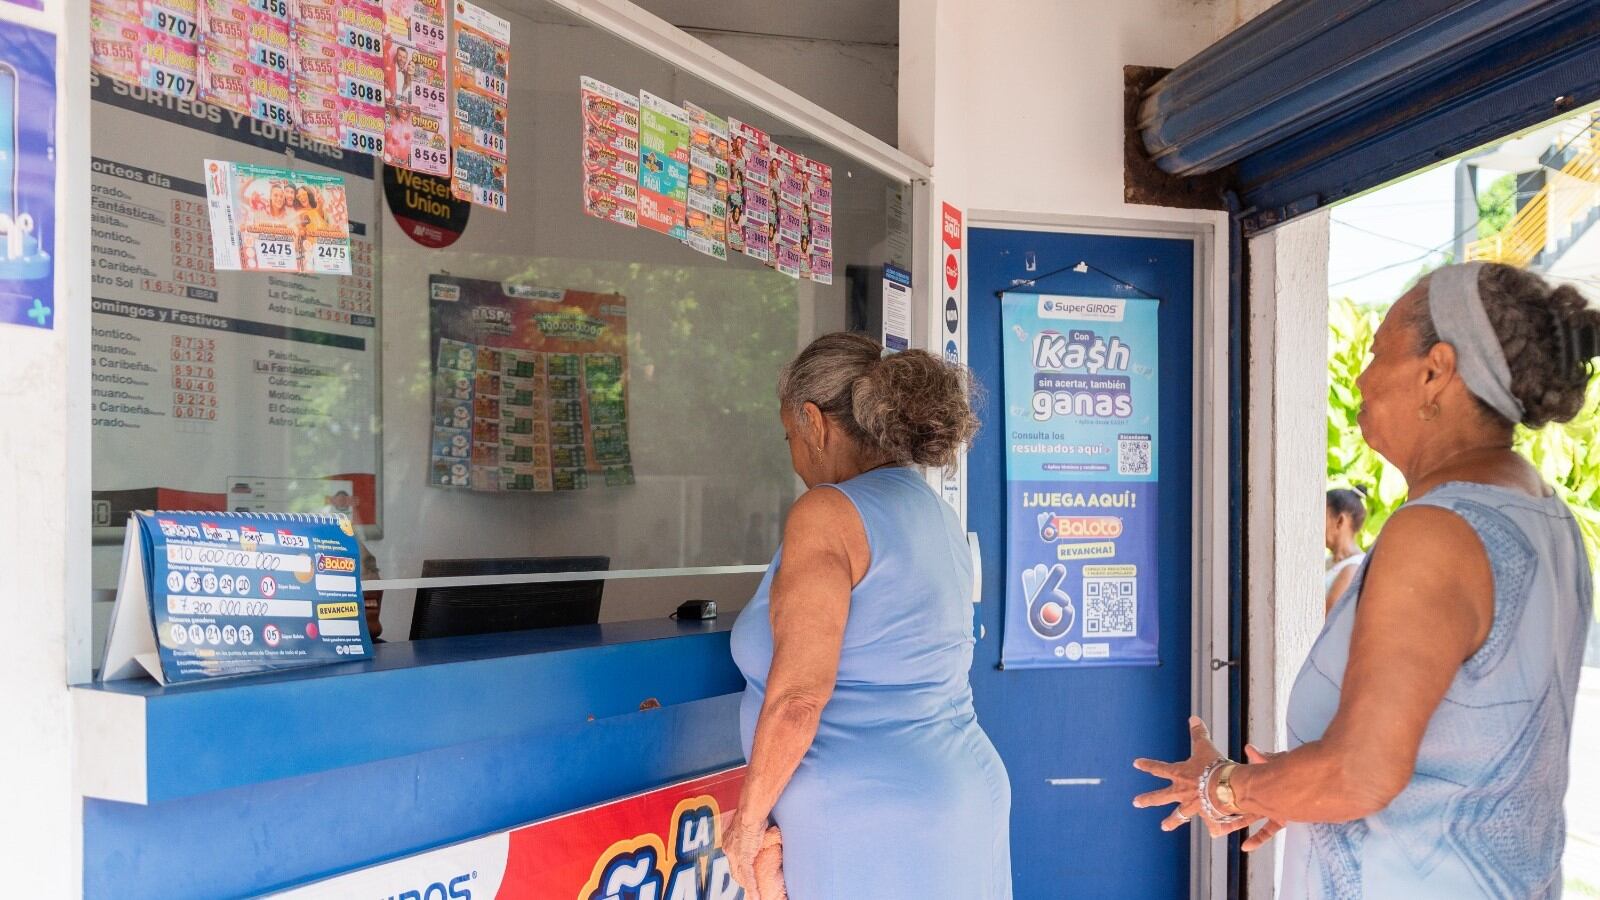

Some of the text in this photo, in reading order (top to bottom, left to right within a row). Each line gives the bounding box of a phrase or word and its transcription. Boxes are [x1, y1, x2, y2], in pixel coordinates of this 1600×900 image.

[262, 0, 287, 17] 156
[157, 12, 197, 39] 9707
[414, 22, 445, 41] 8565
[350, 31, 381, 53] 3088
[261, 49, 289, 69] 156
[155, 70, 195, 94] 9707
[485, 75, 505, 94] 8460
[350, 82, 382, 102] 3088
[414, 86, 445, 102] 8565
[113, 80, 221, 123] SORTEOS
[229, 114, 244, 129] Y
[351, 132, 383, 151] 3088
[483, 133, 504, 151] 8460
[414, 147, 447, 165] 8565
[92, 161, 145, 181] orteos
[92, 184, 123, 196] orado
[396, 167, 460, 204] Wester
[405, 190, 450, 219] Union
[483, 189, 504, 207] 8460
[92, 228, 133, 243] hontico
[944, 219, 960, 239] aquí
[260, 242, 292, 256] 2475
[318, 246, 346, 259] 2475
[92, 273, 113, 285] stro
[116, 276, 133, 288] Sol
[92, 300, 228, 328] omingos y Festivos
[92, 327, 132, 340] hontico
[1074, 331, 1090, 341] Con
[92, 372, 133, 385] hontico
[1039, 377, 1126, 390] sin acertar, también
[1033, 392, 1132, 421] ganas
[92, 418, 124, 428] orado
[1012, 431, 1065, 441] Consulta los
[1012, 443, 1103, 456] resultados aquí
[1023, 490, 1137, 508] ¡JUEGA AQUÍ!
[1058, 518, 1120, 536] Baloto
[243, 531, 264, 545] Sept
[282, 535, 304, 547] 2023
[1060, 546, 1112, 557] REVANCHA!
[325, 557, 356, 571] Baloto
[319, 605, 357, 615] REVANCHA!
[682, 815, 710, 853] LA
